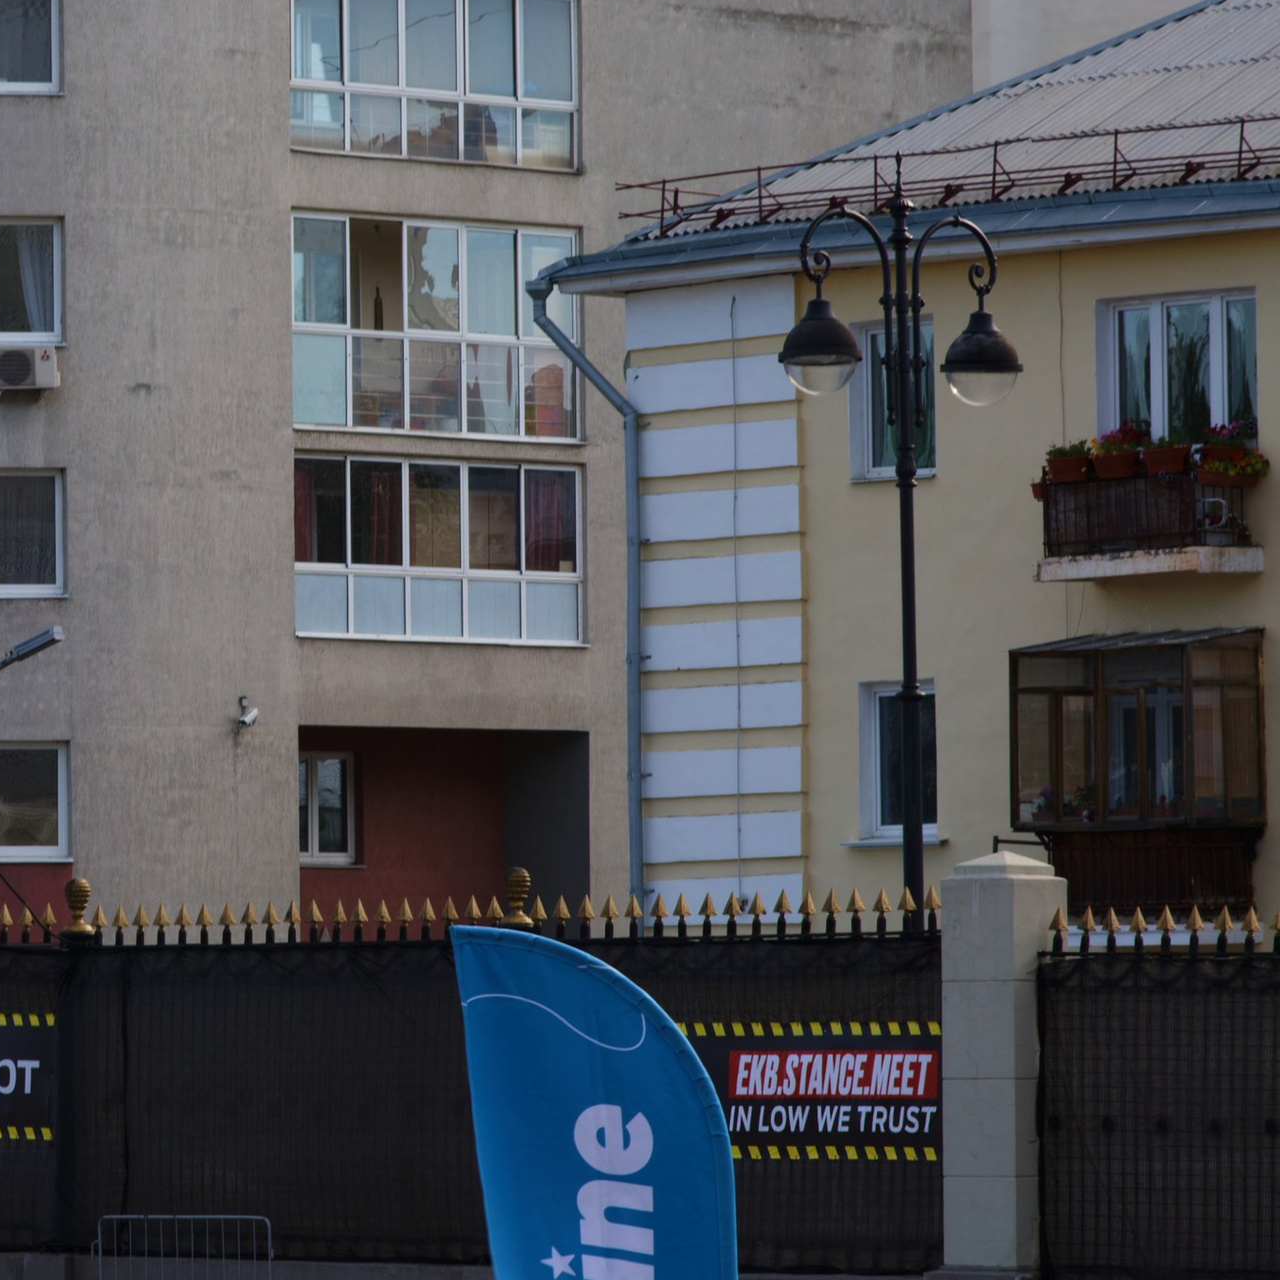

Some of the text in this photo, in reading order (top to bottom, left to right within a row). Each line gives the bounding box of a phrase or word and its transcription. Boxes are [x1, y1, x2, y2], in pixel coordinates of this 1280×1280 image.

[735, 1053, 932, 1096] EKB.STANCE.MEET
[729, 1105, 937, 1134] IN LOW WE TRUST
